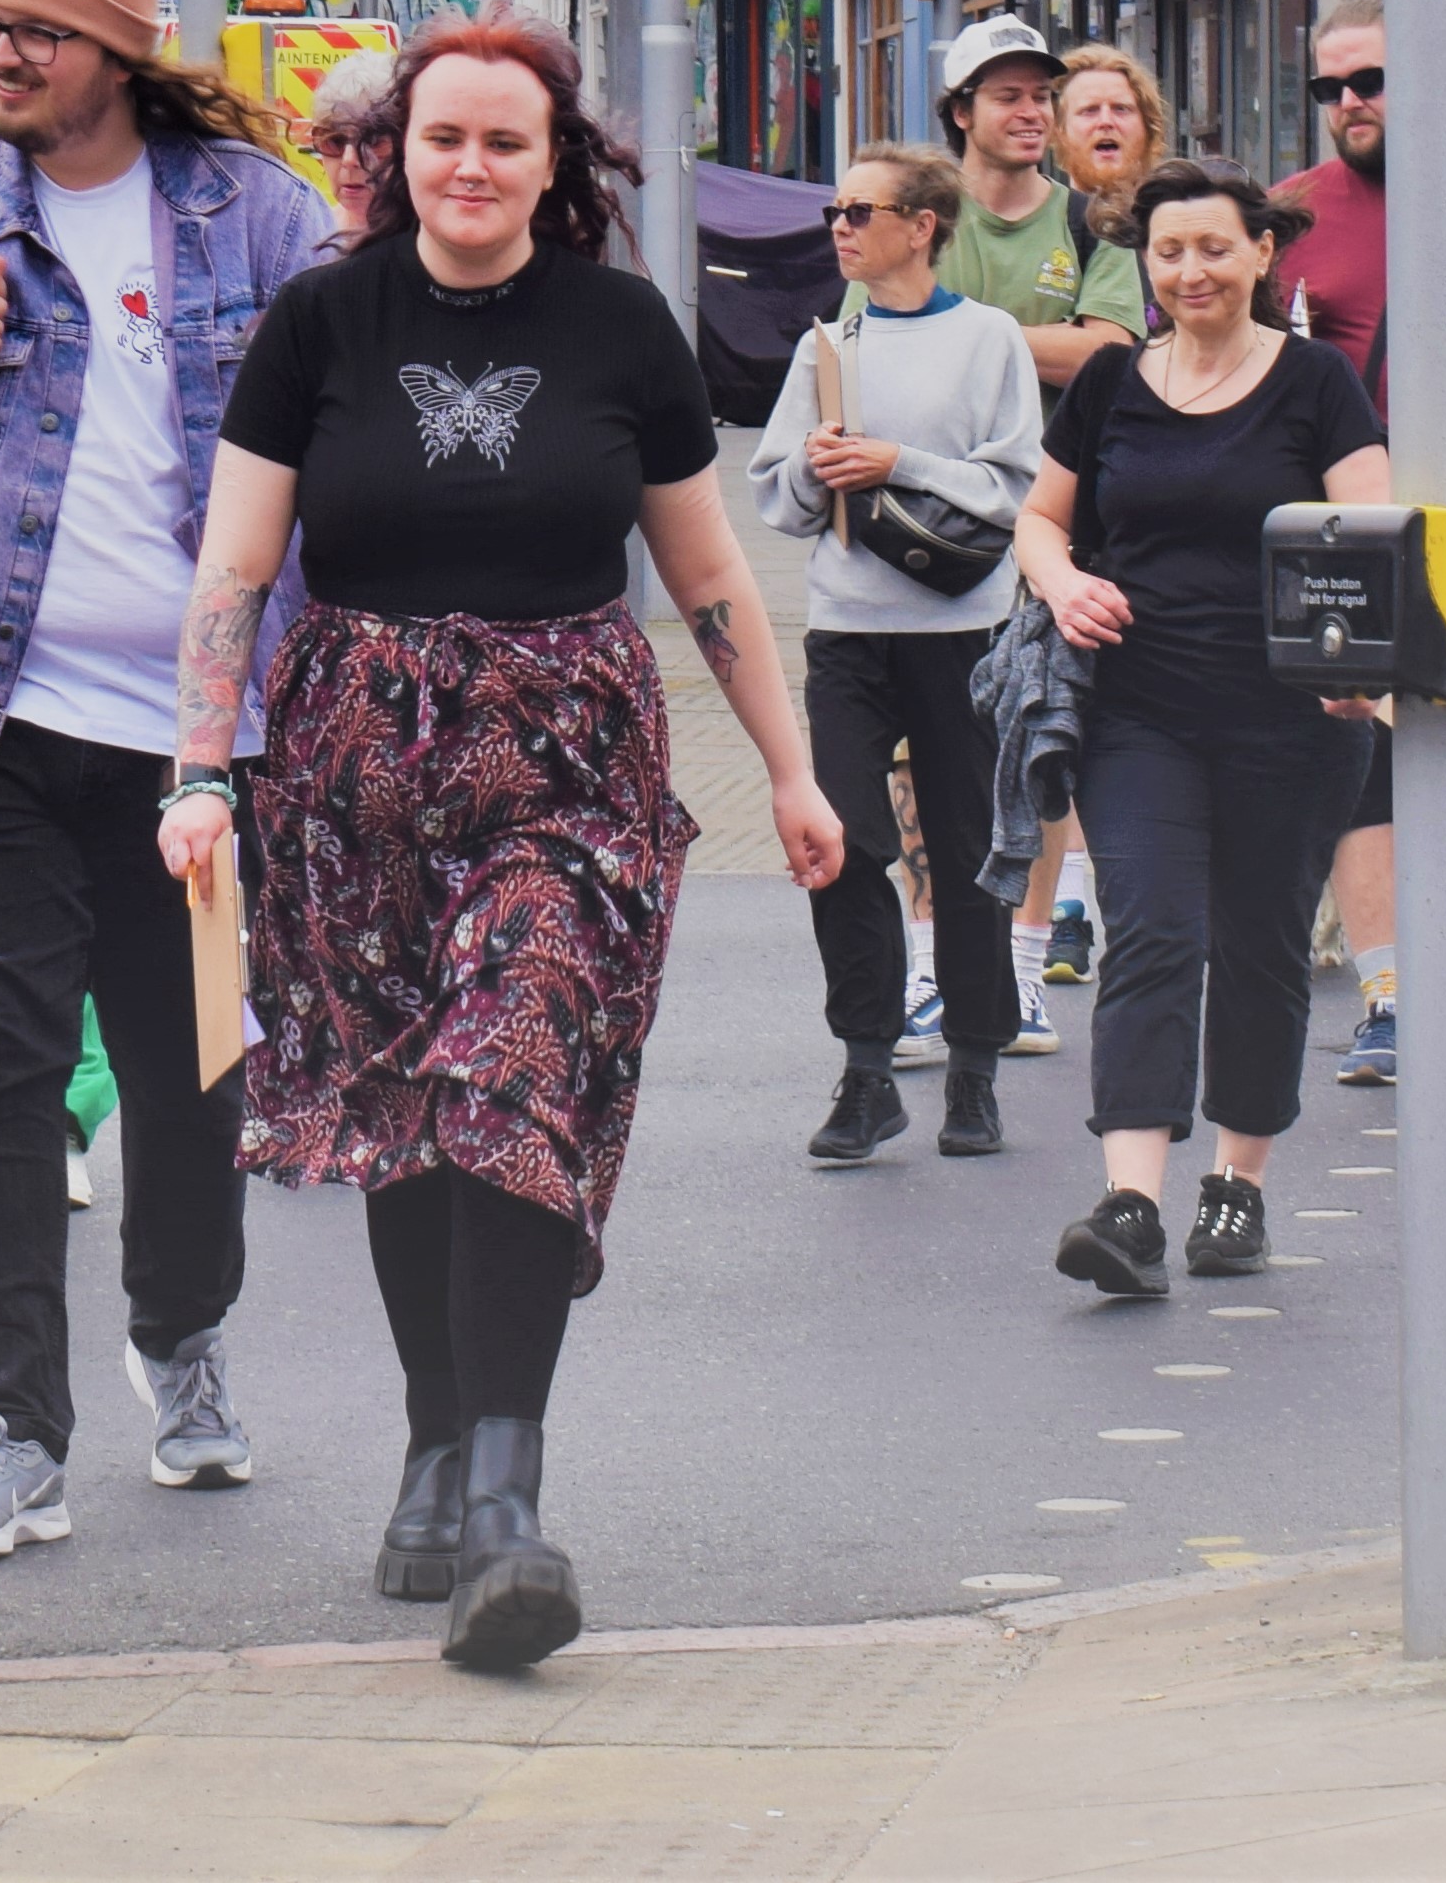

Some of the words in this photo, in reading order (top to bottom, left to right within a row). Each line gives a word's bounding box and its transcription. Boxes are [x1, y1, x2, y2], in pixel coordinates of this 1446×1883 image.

[277, 52, 349, 65] AINTENA
[1304, 576, 1328, 590] Push
[1330, 576, 1362, 590] button
[1299, 591, 1321, 605] Wait
[1322, 591, 1336, 605] for
[1338, 592, 1367, 609] signal
